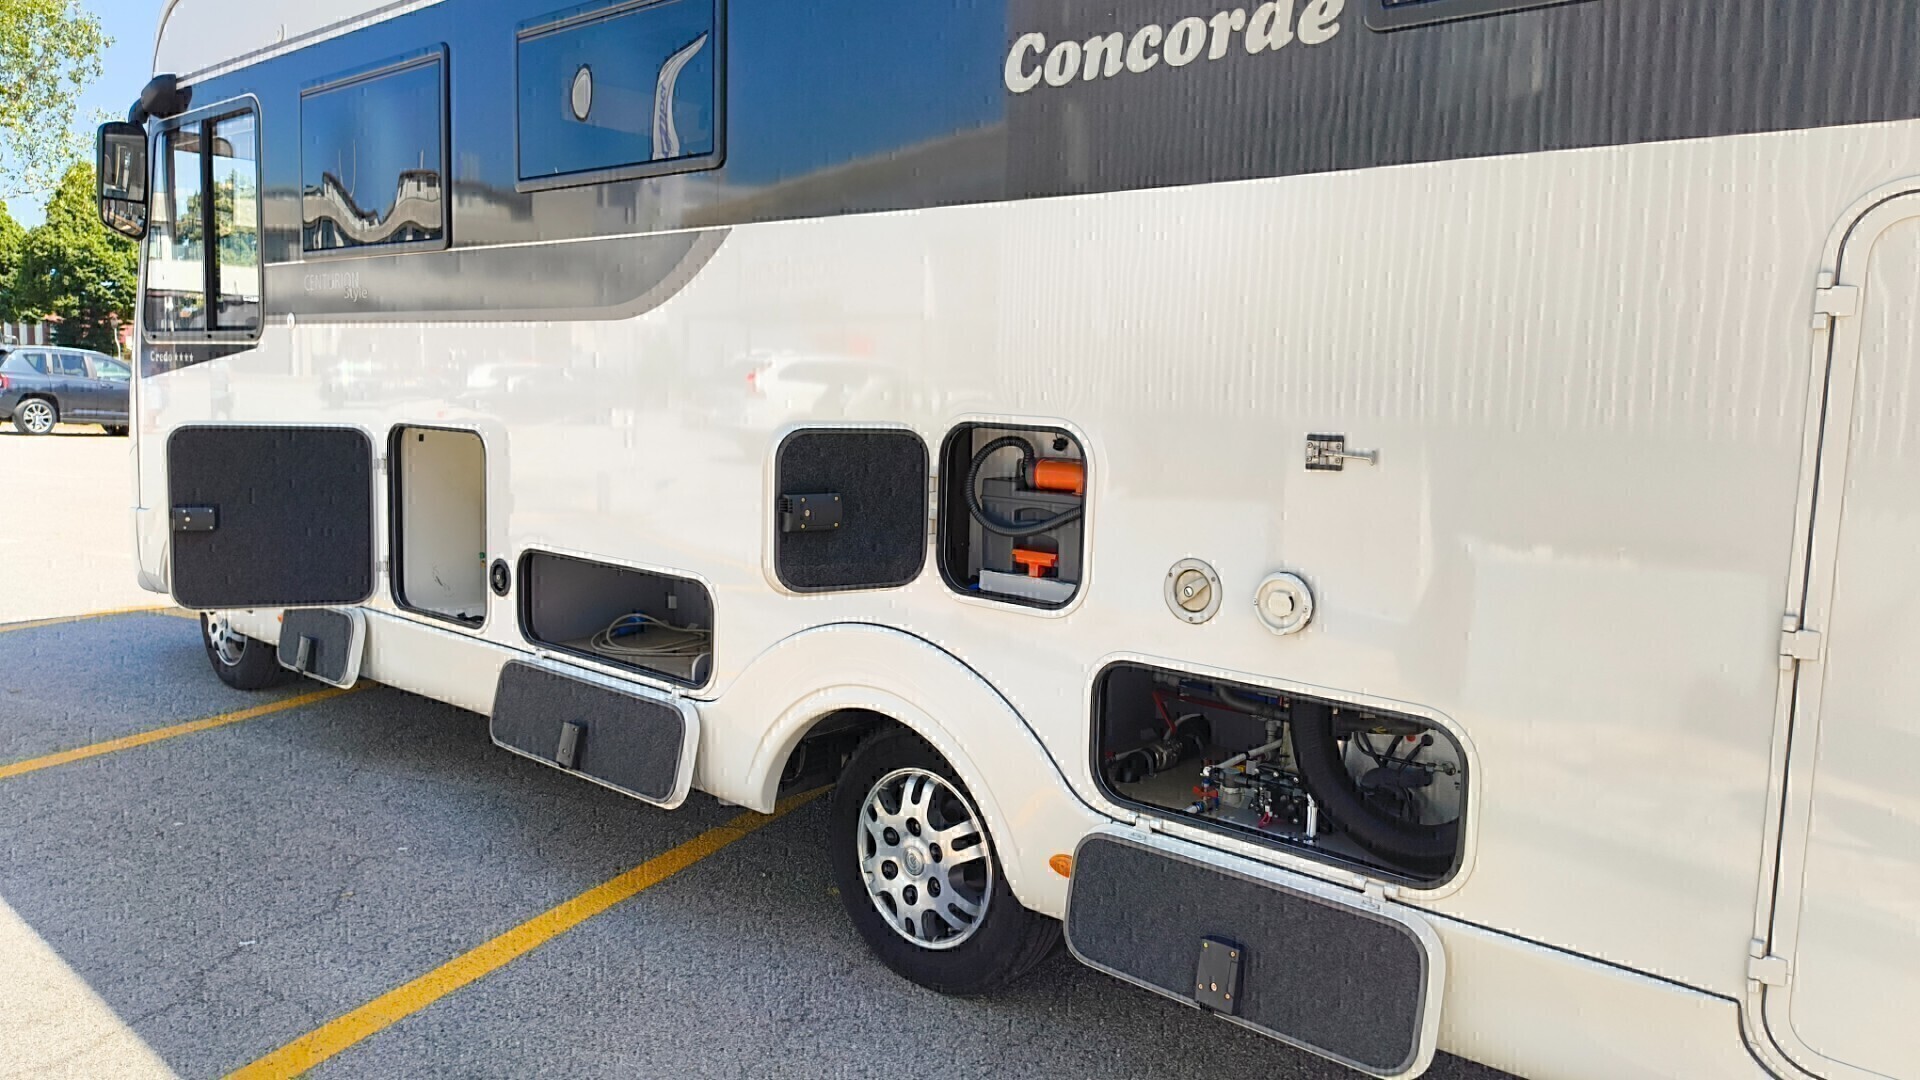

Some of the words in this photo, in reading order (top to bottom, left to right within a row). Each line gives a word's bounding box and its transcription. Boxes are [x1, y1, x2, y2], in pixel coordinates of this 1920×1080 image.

[1004, 0, 1345, 93] Concorde
[304, 271, 359, 292] CENTURION
[344, 286, 368, 302] Style
[150, 350, 173, 362] Credo
